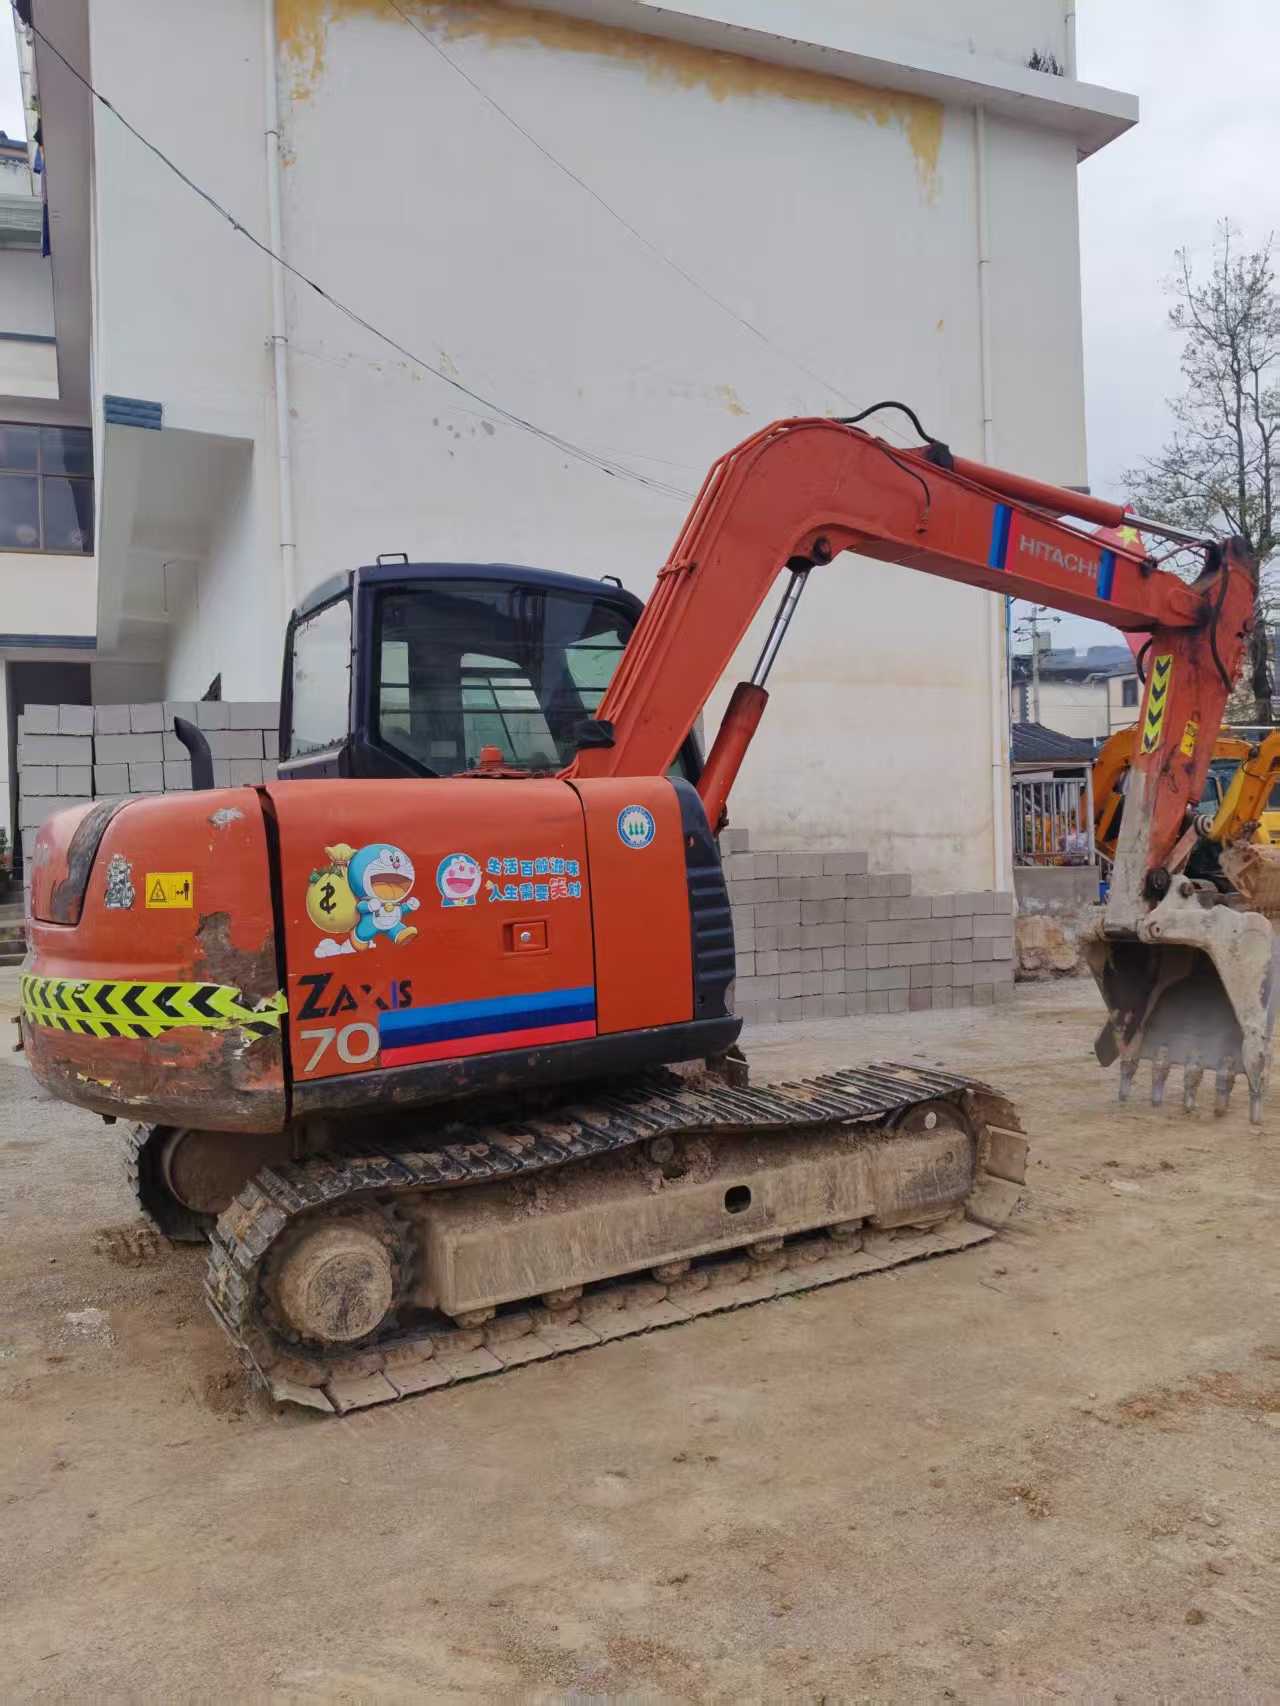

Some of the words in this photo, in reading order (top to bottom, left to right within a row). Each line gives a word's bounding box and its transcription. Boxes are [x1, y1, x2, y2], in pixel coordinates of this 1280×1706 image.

[486, 876, 582, 903] 人生需要笑对
[300, 1022, 381, 1073] 70
